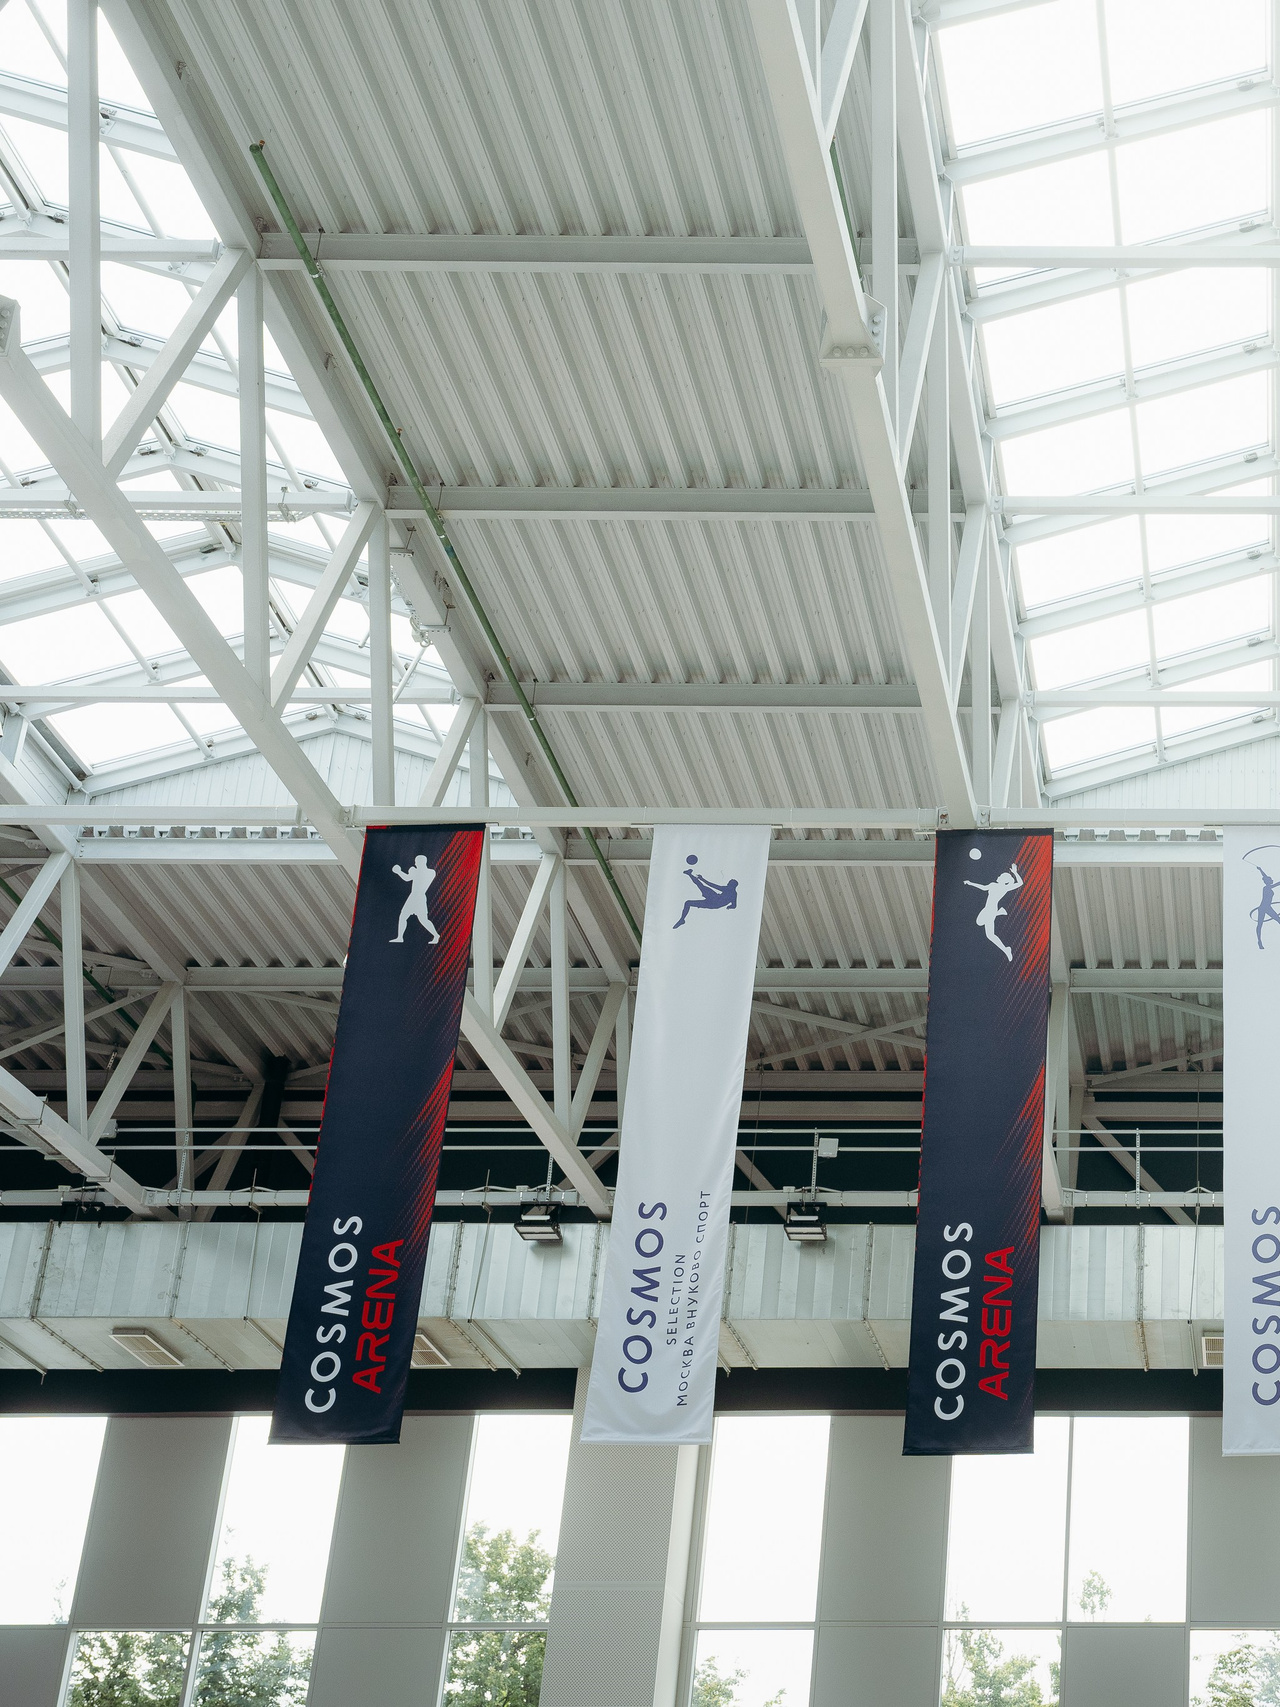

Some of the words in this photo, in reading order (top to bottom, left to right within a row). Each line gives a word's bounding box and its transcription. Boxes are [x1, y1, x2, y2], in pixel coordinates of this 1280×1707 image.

[305, 1216, 362, 1413] COSMOS
[353, 1240, 404, 1393] ARENA
[618, 1202, 667, 1393] COSMOS
[666, 1255, 685, 1345] SELECTION
[677, 1336, 694, 1406] МОСКВА
[686, 1251, 701, 1329] ВНУКОВО
[695, 1191, 710, 1244] СПОРТ
[934, 1223, 973, 1420] COSMOS
[979, 1246, 1014, 1400] ARENA
